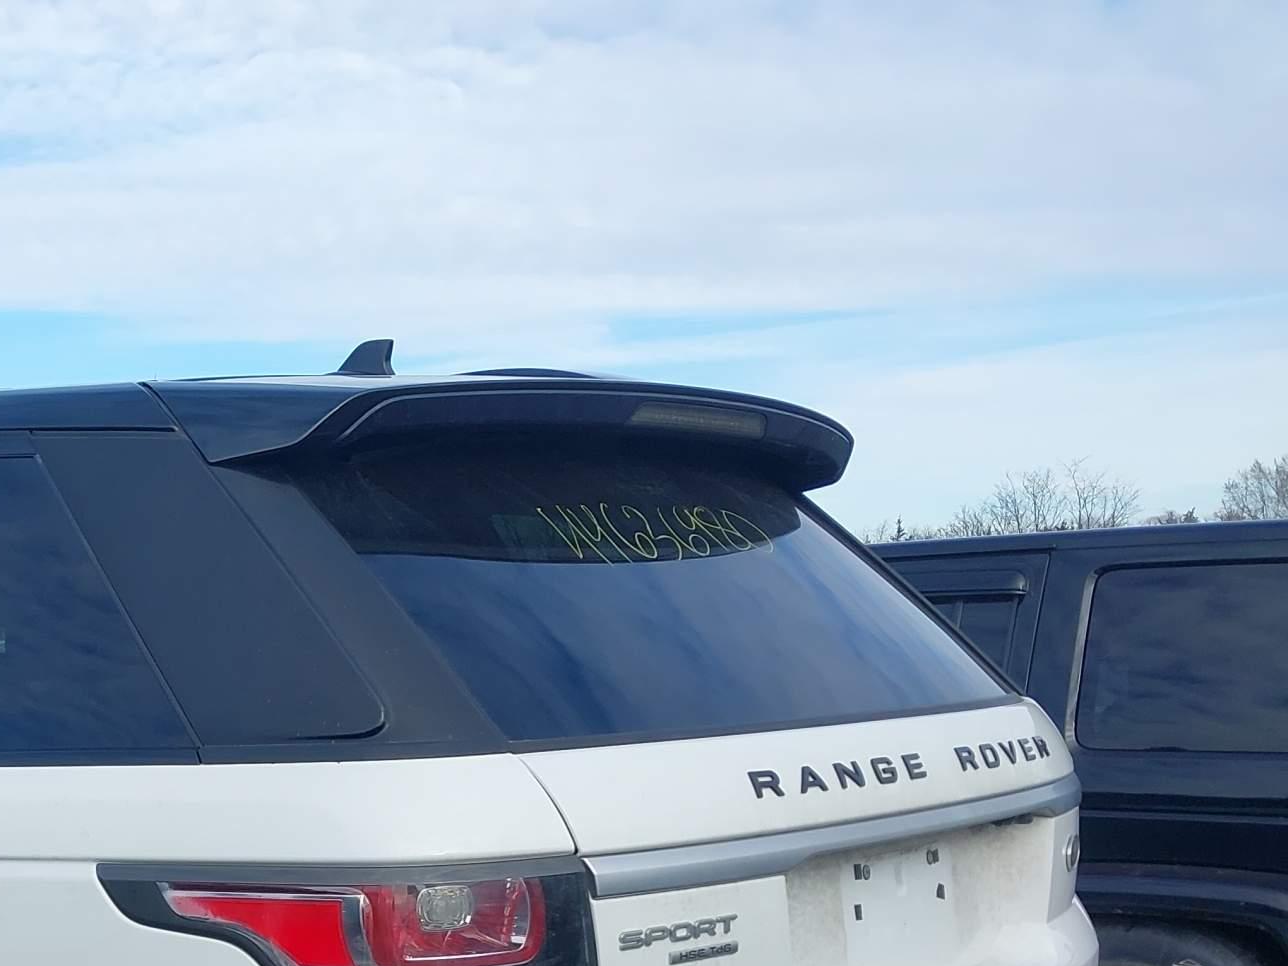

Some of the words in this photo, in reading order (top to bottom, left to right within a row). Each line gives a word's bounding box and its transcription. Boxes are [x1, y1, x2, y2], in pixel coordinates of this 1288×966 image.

[747, 752, 928, 799] RANGE
[953, 735, 1051, 773] ROVER
[618, 913, 738, 952] SPORT
[679, 947, 706, 961] HSE
